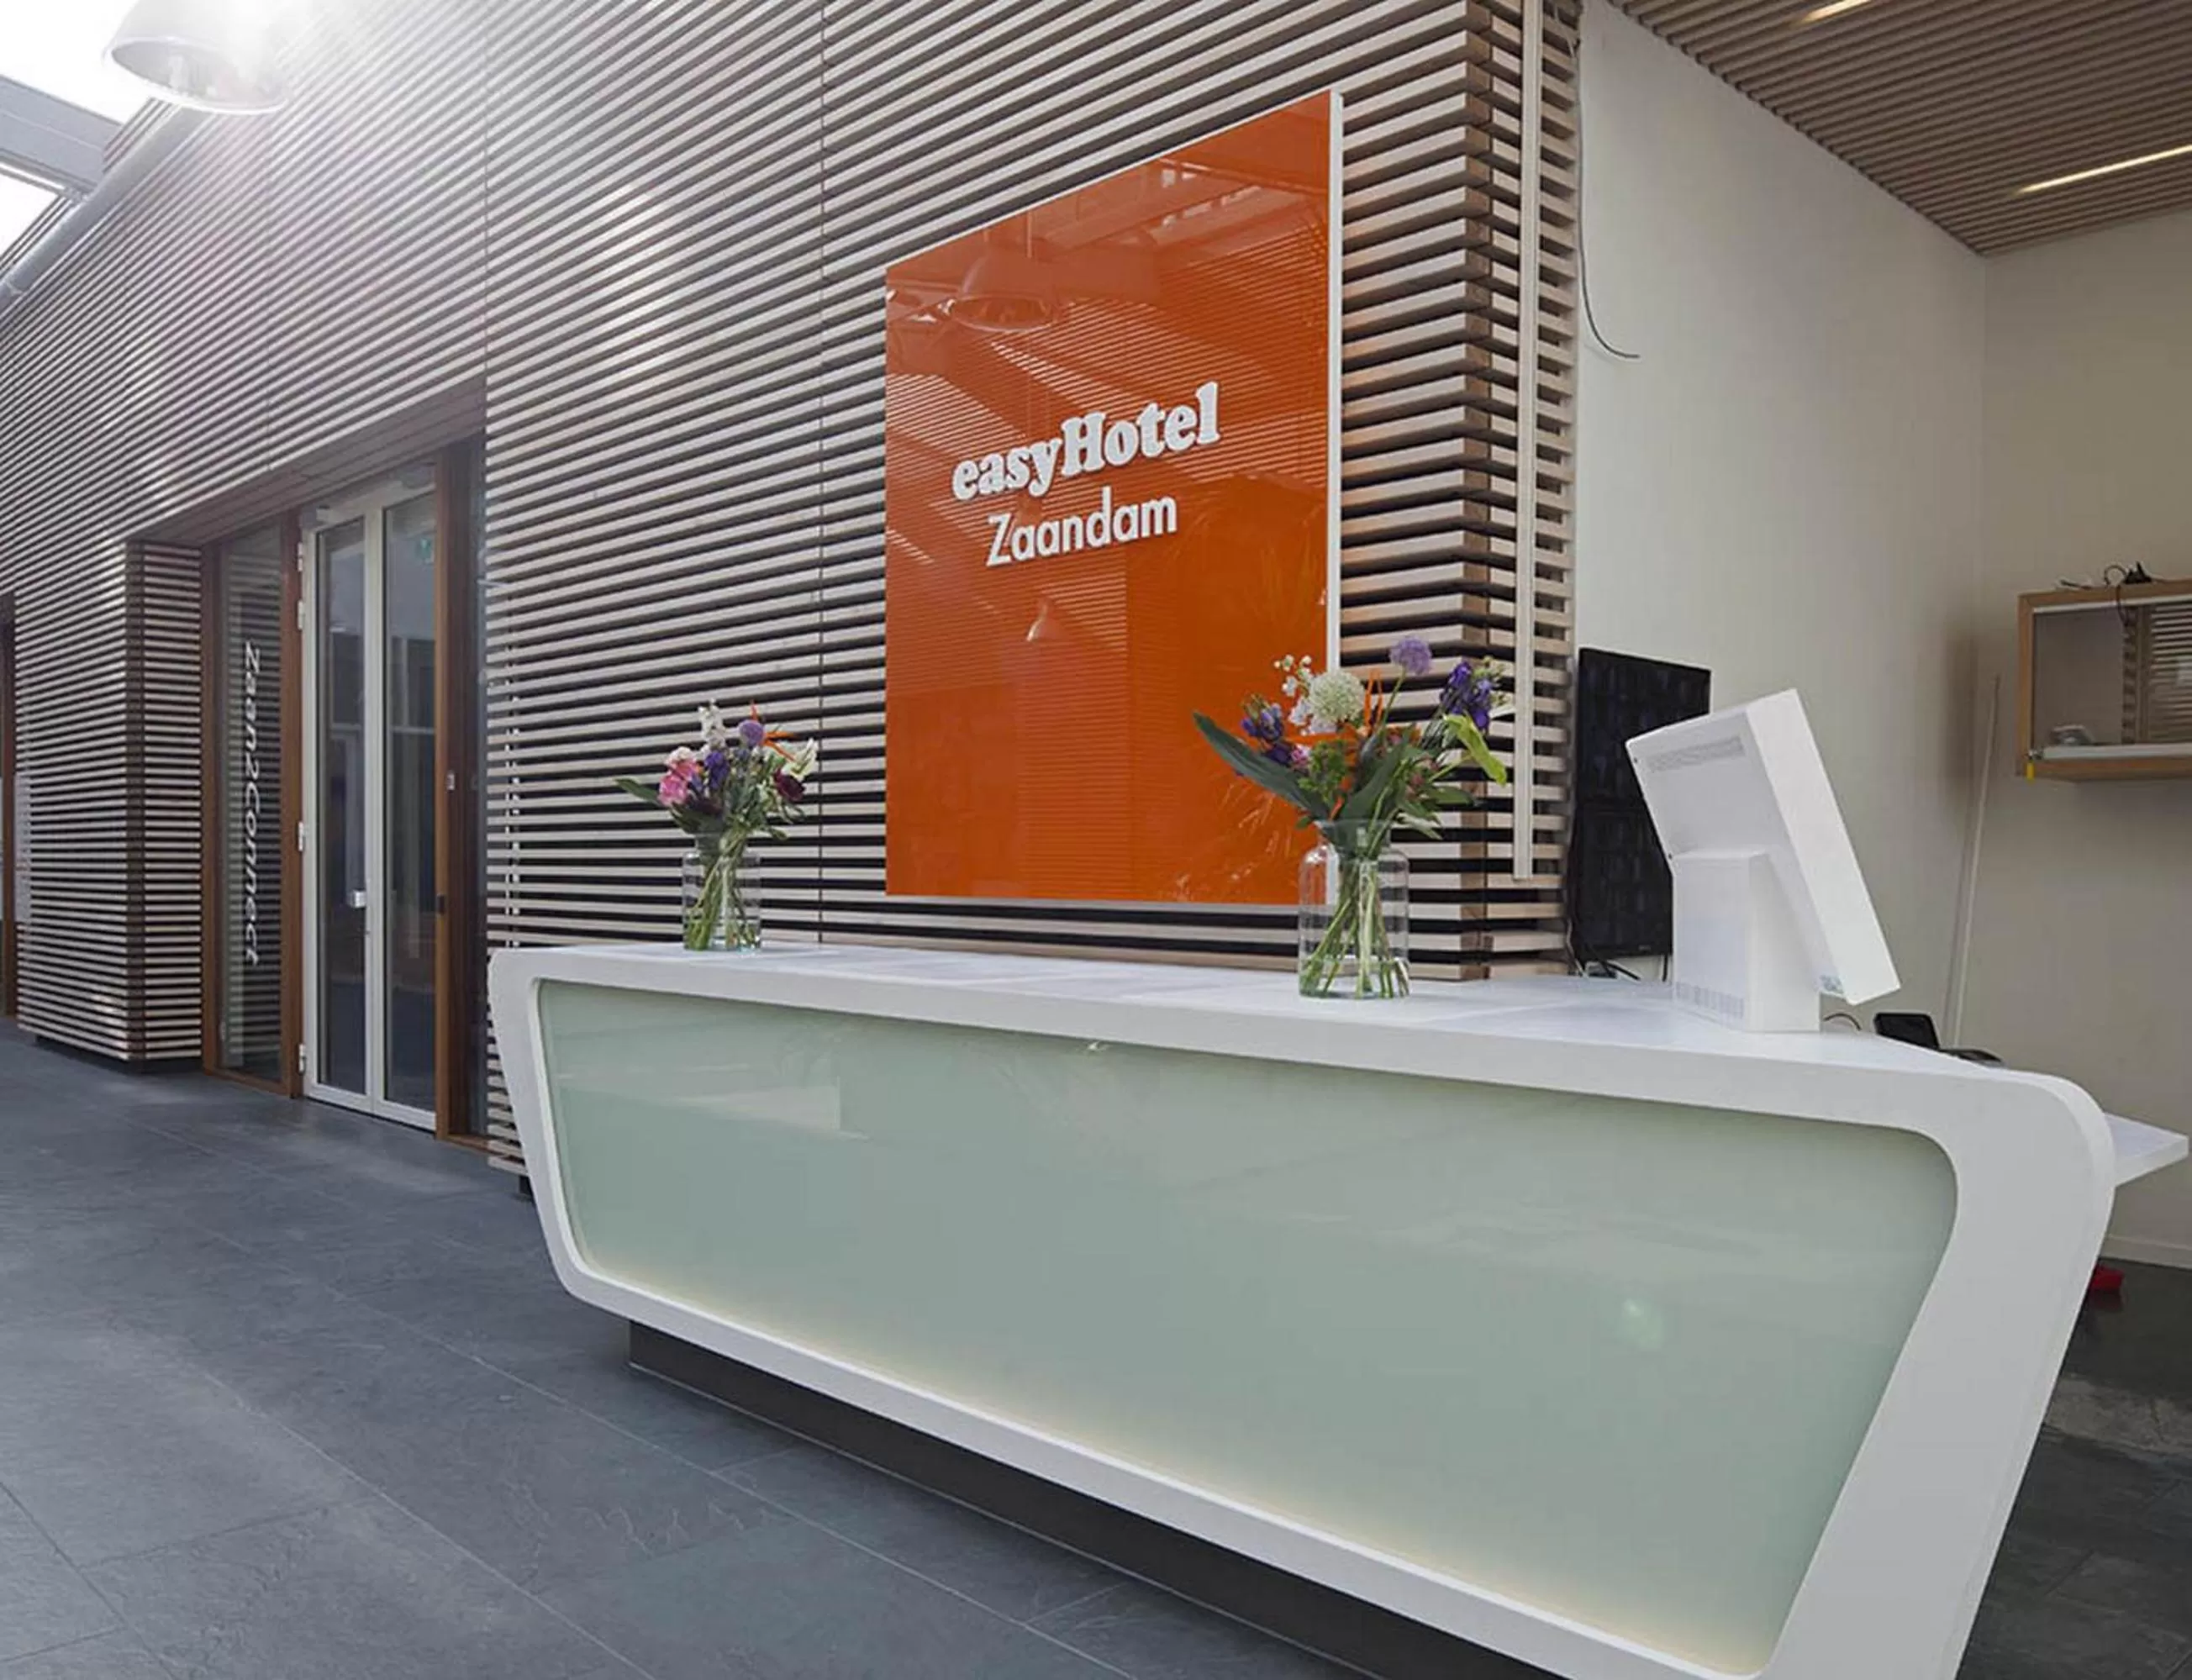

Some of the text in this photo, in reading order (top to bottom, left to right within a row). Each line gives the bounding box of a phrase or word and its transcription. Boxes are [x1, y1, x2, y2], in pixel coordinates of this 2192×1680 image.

[952, 381, 1220, 500] easyHotel
[986, 486, 1177, 567] Zaandam
[244, 641, 261, 966] Zaan2Connect
